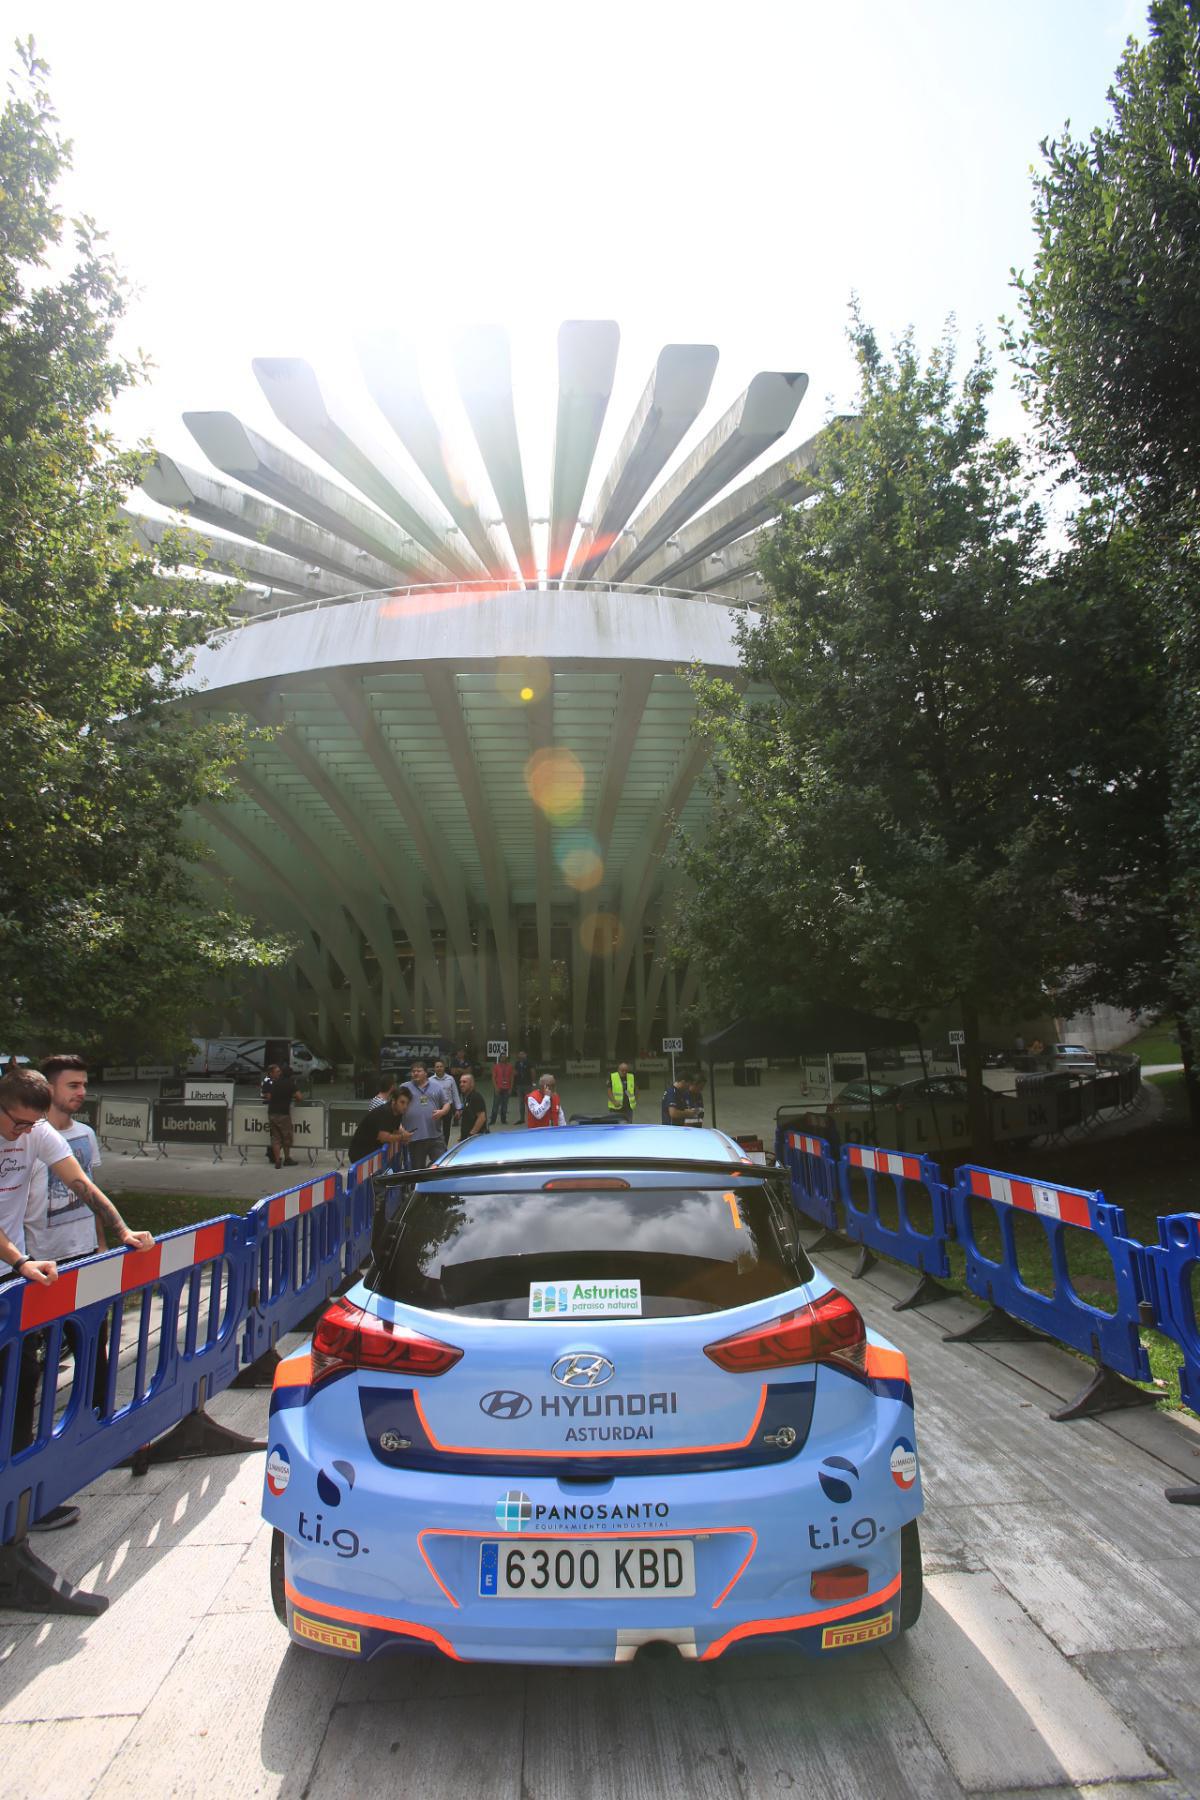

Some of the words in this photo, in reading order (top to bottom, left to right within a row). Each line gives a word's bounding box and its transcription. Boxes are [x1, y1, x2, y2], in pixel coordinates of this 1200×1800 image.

[191, 1090, 227, 1100] Liberbank
[105, 1111, 142, 1129] Liberbank
[162, 1116, 217, 1132] Liberbank
[244, 1118, 311, 1134] Libenk
[722, 1192, 743, 1229] 1
[572, 1284, 638, 1300] Asturias
[607, 1300, 638, 1310] natural
[541, 1392, 677, 1417] HYUNDAI
[565, 1425, 653, 1442] ASTURDAI
[535, 1502, 670, 1520] PANOSANTO
[535, 1522, 607, 1531] EQUIPAMIENTO
[612, 1521, 669, 1529] INDUSTRIAL
[506, 1549, 600, 1589] 6300
[615, 1548, 684, 1589] KBD
[485, 1574, 493, 1587] E
[295, 1615, 358, 1650] PIRELLI
[825, 1615, 891, 1647] PIRELLI
